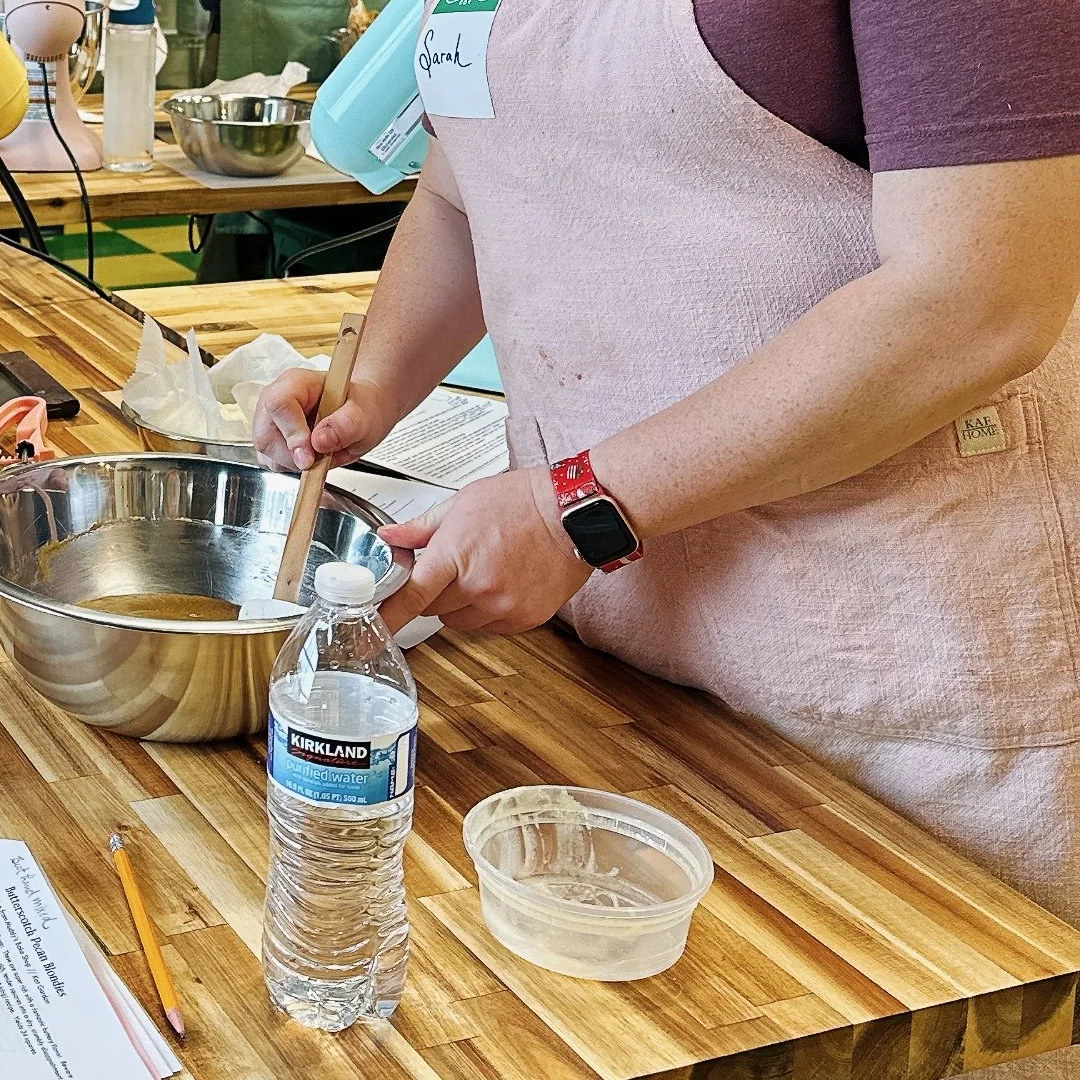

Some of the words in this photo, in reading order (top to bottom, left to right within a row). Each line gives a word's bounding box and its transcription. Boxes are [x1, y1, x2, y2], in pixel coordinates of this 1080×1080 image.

[419, 29, 473, 78] Sarah
[962, 426, 997, 440] HOME
[291, 732, 368, 759] KIRKLAND
[286, 759, 328, 780] purified
[331, 772, 369, 784] water
[343, 794, 357, 803] 500
[357, 796, 368, 804] mL
[20, 873, 40, 897] hand
[32, 897, 57, 929] mixed
[5, 886, 36, 936] Butterscotch
[30, 936, 47, 961] Pecan
[42, 962, 66, 997] Blondies
[21, 954, 31, 967] Shop
